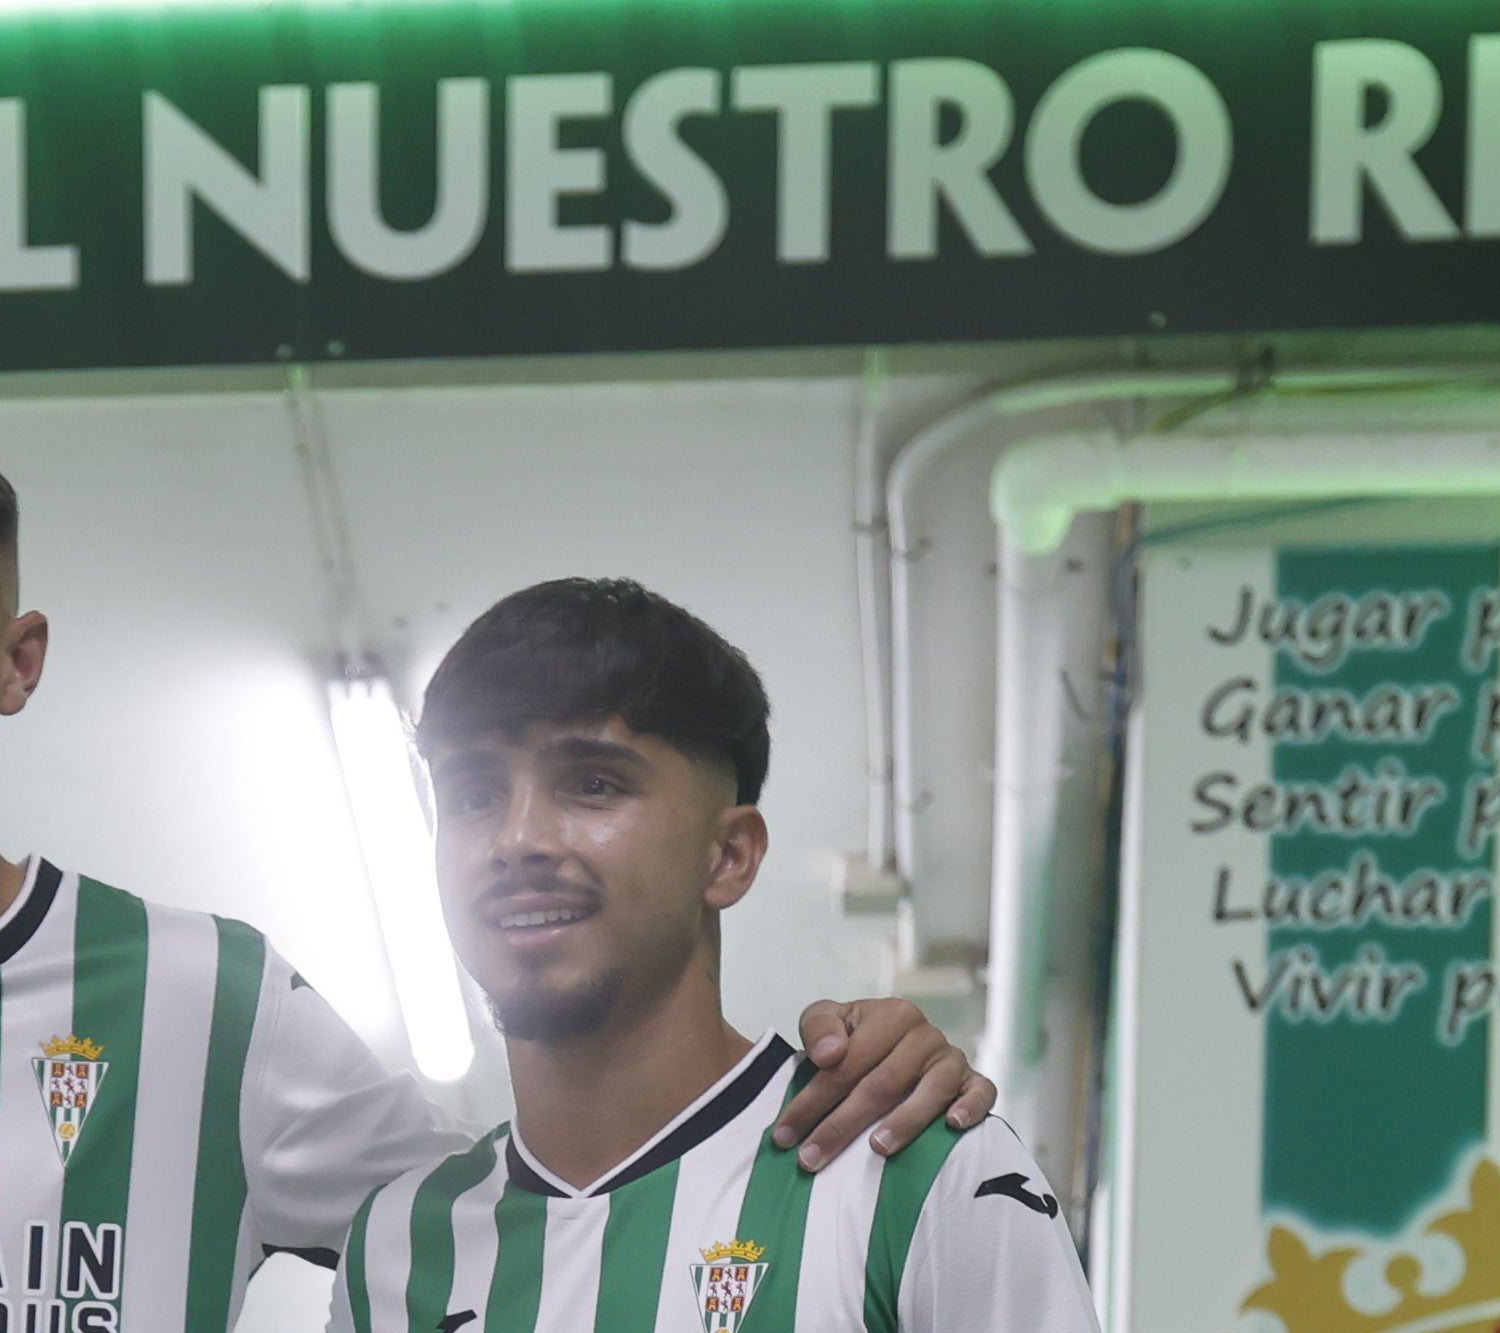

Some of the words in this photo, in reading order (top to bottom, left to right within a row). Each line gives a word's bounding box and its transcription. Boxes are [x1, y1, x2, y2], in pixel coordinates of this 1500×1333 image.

[141, 45, 1235, 287] NUESTRO
[1207, 583, 1445, 667] Jugar
[1201, 677, 1457, 741] Ganar
[1190, 763, 1442, 833] Sentir
[1212, 849, 1490, 925] Luchar
[1233, 950, 1425, 1020] Vivir
